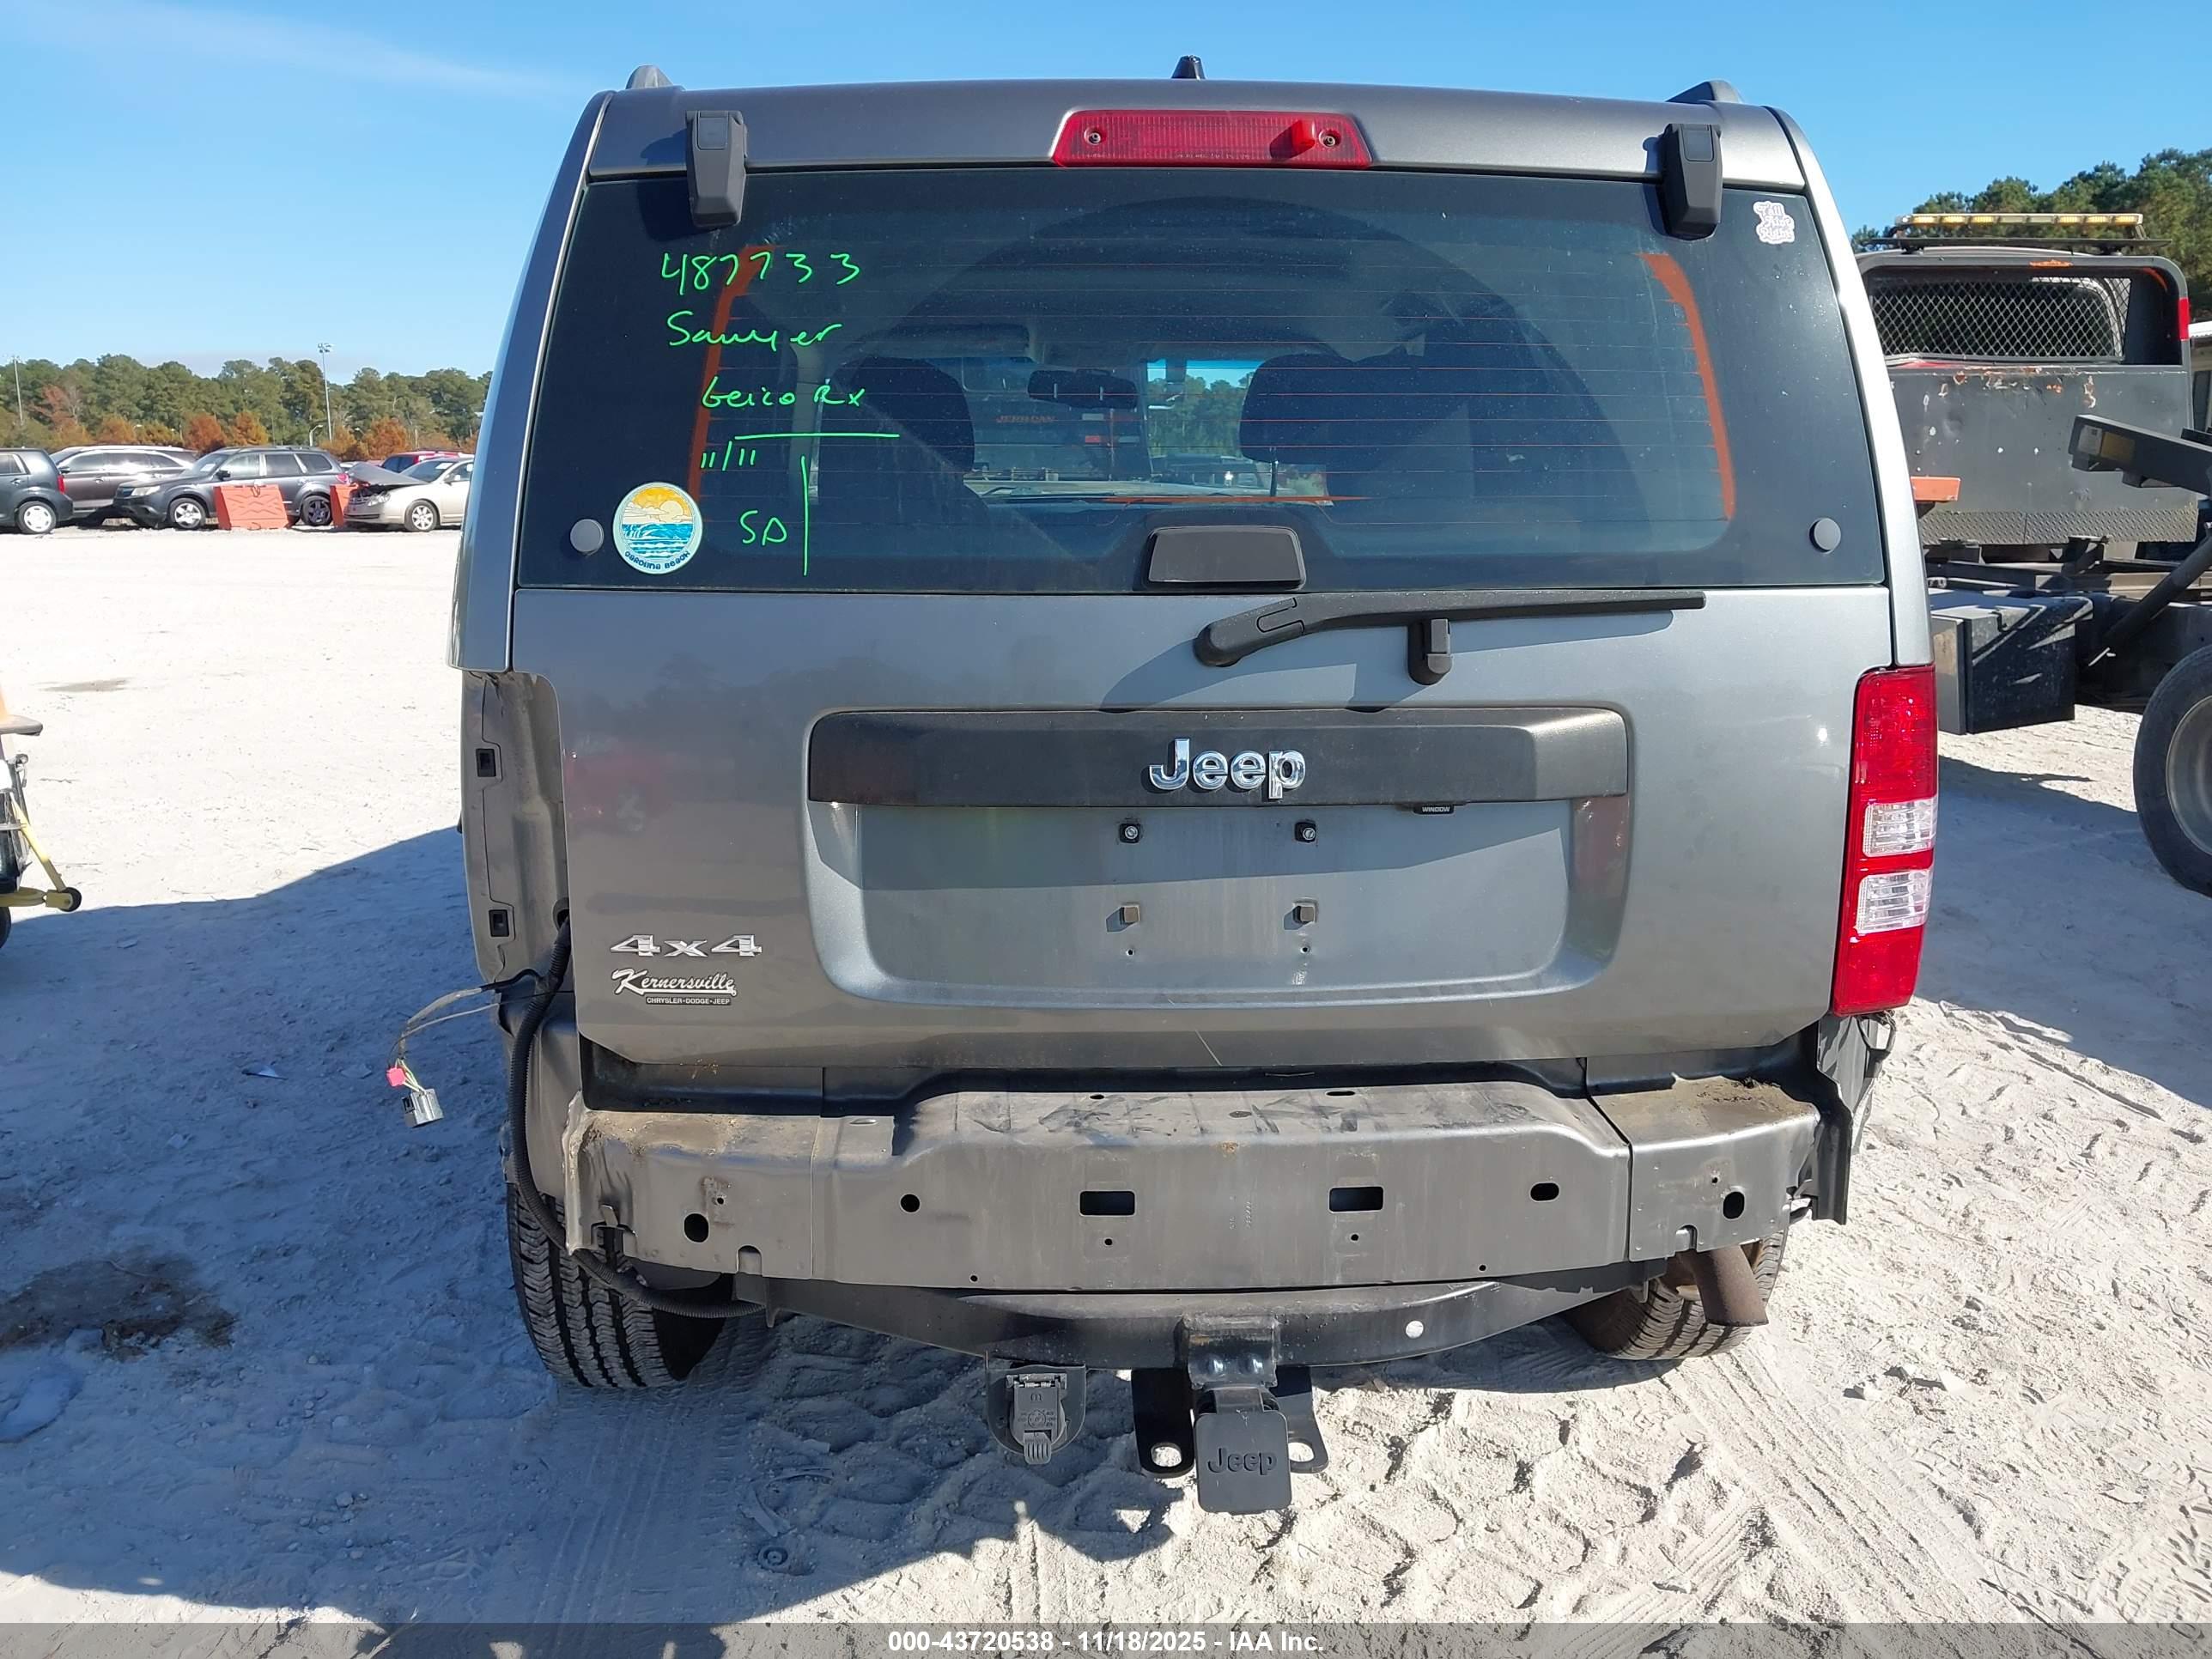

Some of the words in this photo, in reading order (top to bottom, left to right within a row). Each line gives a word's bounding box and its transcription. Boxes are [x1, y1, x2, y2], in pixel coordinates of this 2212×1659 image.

[660, 250, 861, 296] 487733
[665, 309, 842, 353] Sawyer
[700, 440, 757, 471] 11/11
[1149, 737, 1307, 800] Jeep
[611, 933, 763, 957] 4x4
[611, 967, 738, 997] Kernersville
[1206, 1448, 1278, 1476] Jeep
